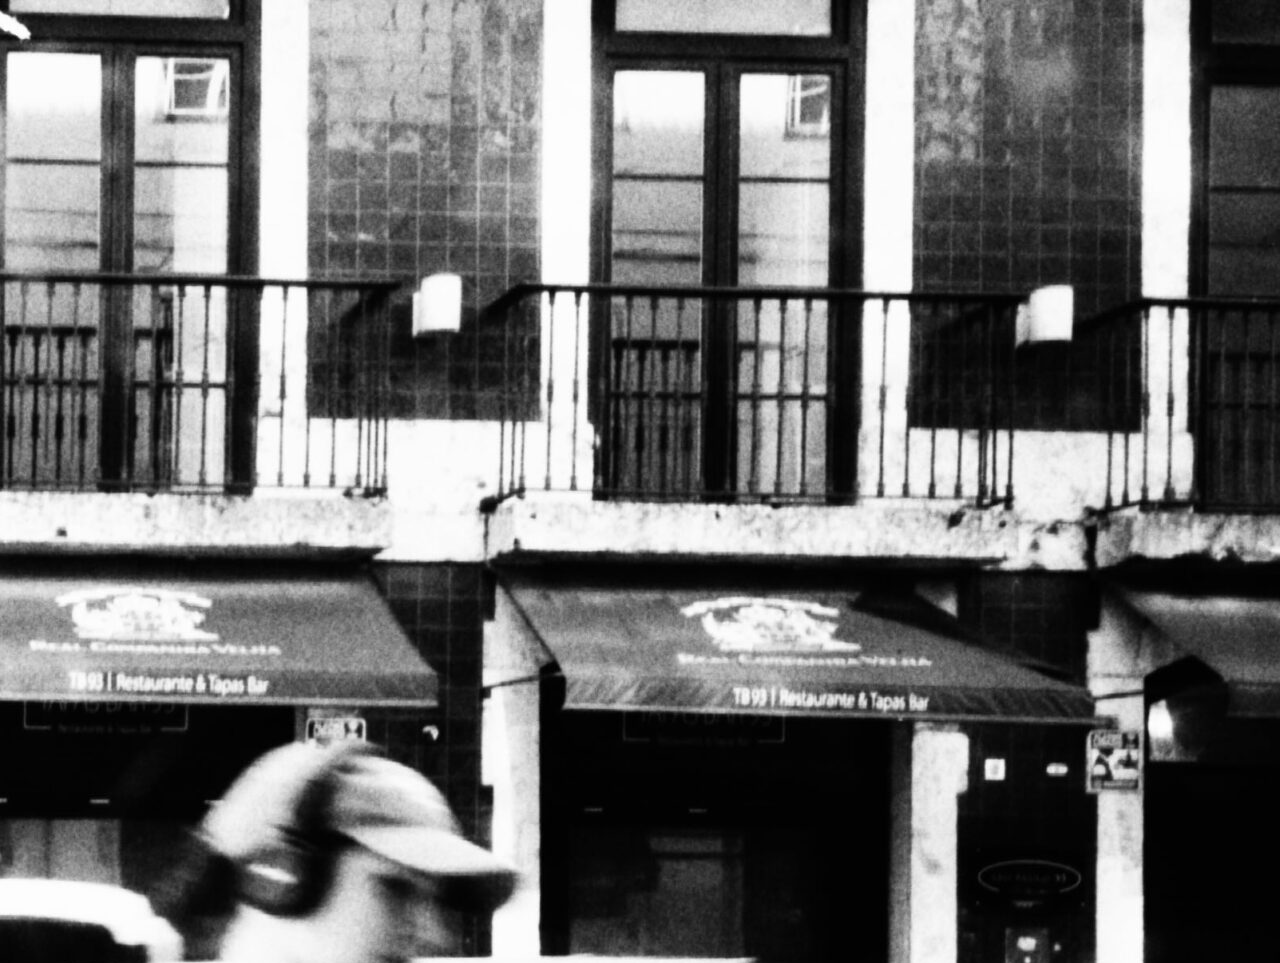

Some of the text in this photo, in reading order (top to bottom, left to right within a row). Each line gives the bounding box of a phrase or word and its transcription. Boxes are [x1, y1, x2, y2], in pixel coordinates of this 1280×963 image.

[116, 671, 194, 693] Restaurante
[208, 673, 245, 696] Tapas
[247, 674, 270, 694] Bar
[779, 687, 855, 709] Restaurante
[858, 690, 868, 709] &
[870, 691, 906, 713] Tapas
[908, 691, 930, 711] Bar
